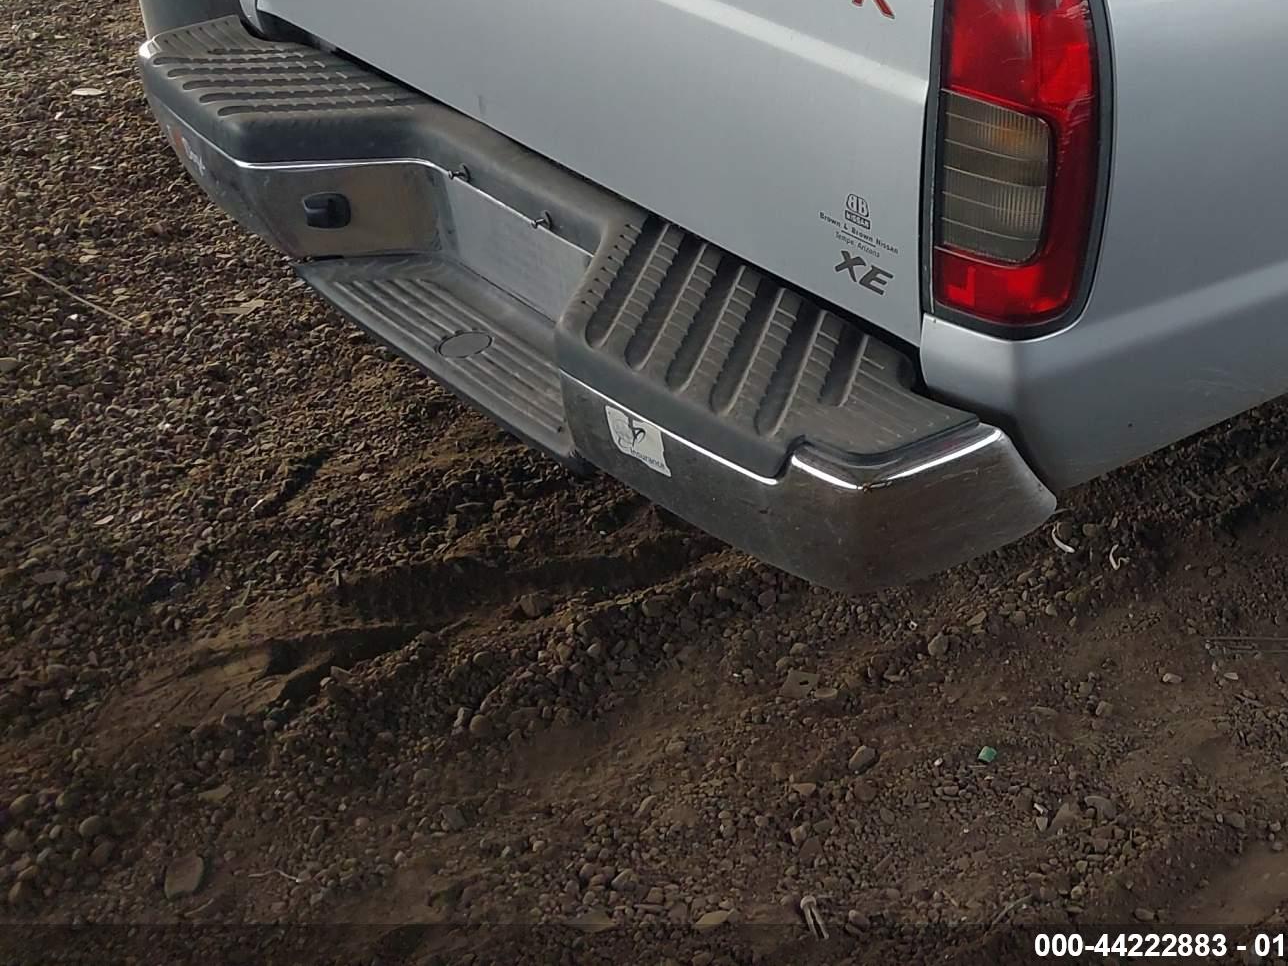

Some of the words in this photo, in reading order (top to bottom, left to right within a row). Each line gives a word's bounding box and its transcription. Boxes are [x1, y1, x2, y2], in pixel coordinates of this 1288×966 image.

[819, 211, 842, 228] Brown
[851, 227, 874, 243] Brown
[875, 237, 899, 255] Nissan
[834, 250, 895, 296] XE
